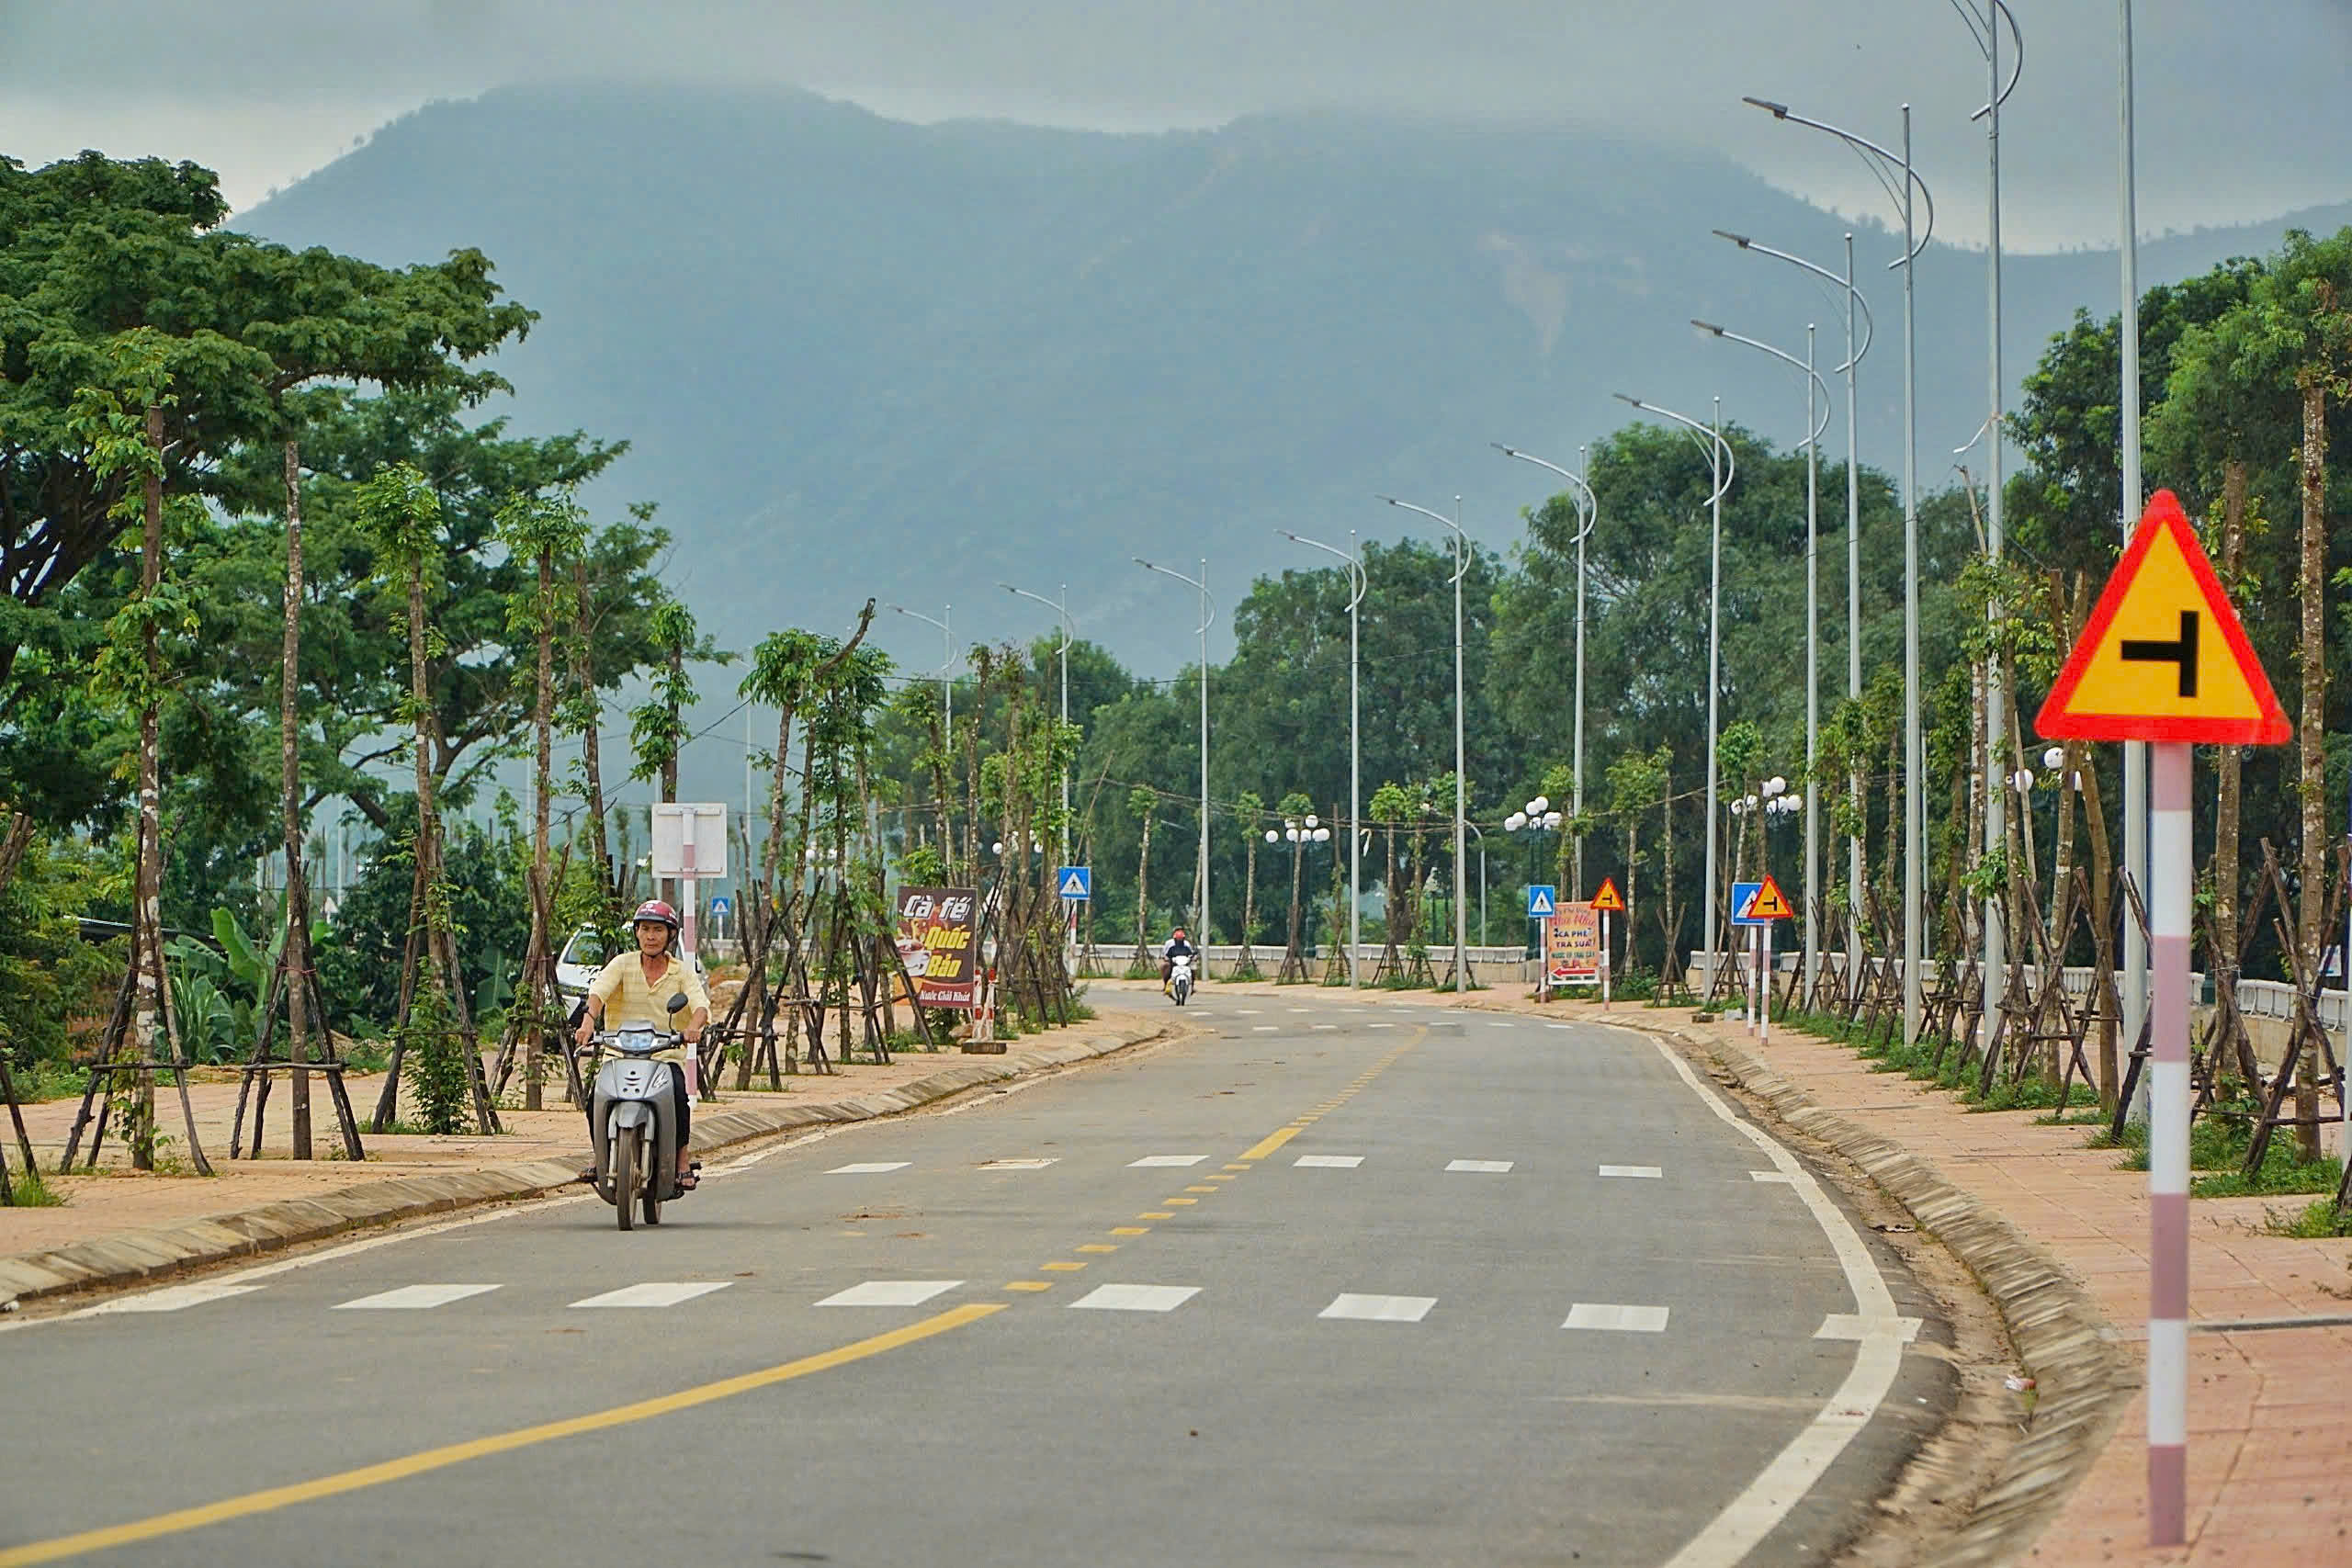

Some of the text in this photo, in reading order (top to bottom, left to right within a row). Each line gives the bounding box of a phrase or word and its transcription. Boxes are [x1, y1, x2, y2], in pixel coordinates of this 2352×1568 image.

[903, 895, 933, 919] Cà
[924, 924, 971, 950] Quốc
[925, 953, 962, 977] Bảo
